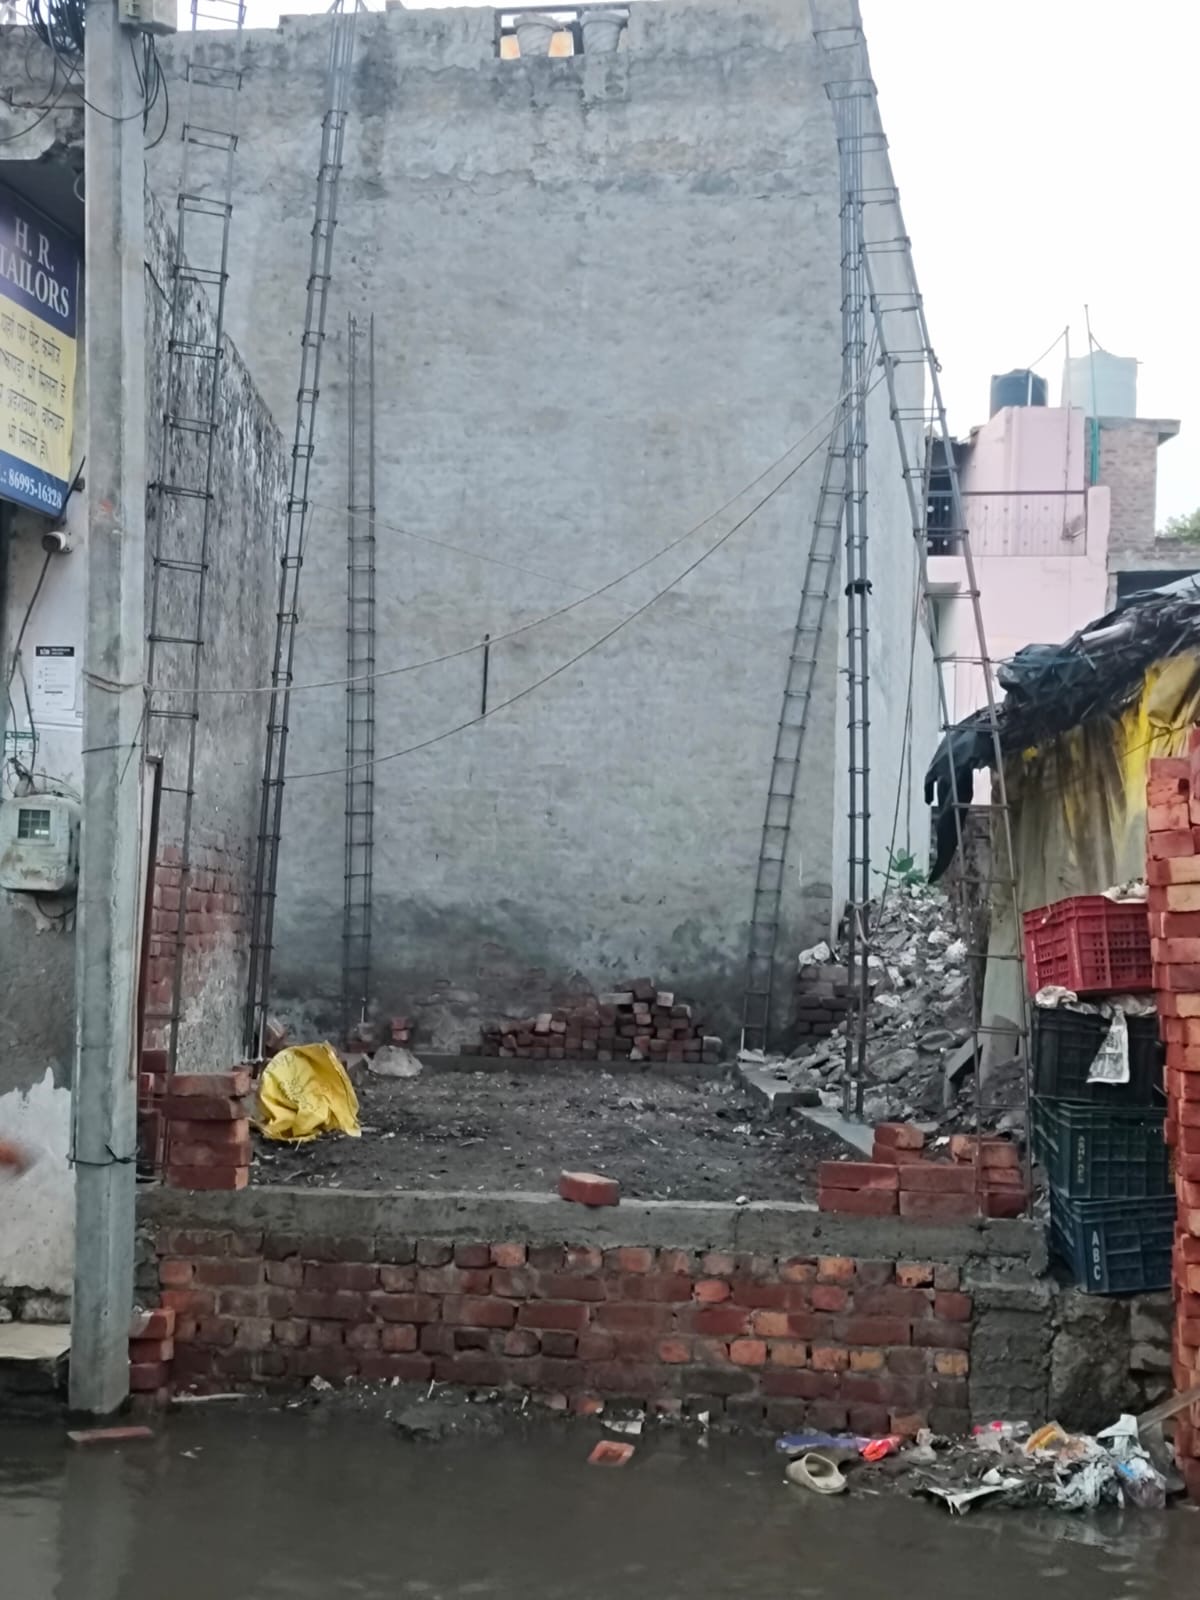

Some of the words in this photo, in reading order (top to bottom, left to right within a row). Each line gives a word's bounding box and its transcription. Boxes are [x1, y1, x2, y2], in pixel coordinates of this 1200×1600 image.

[15, 215, 33, 257] H.
[38, 232, 55, 273] R.
[1091, 1230, 1102, 1281] ABC
